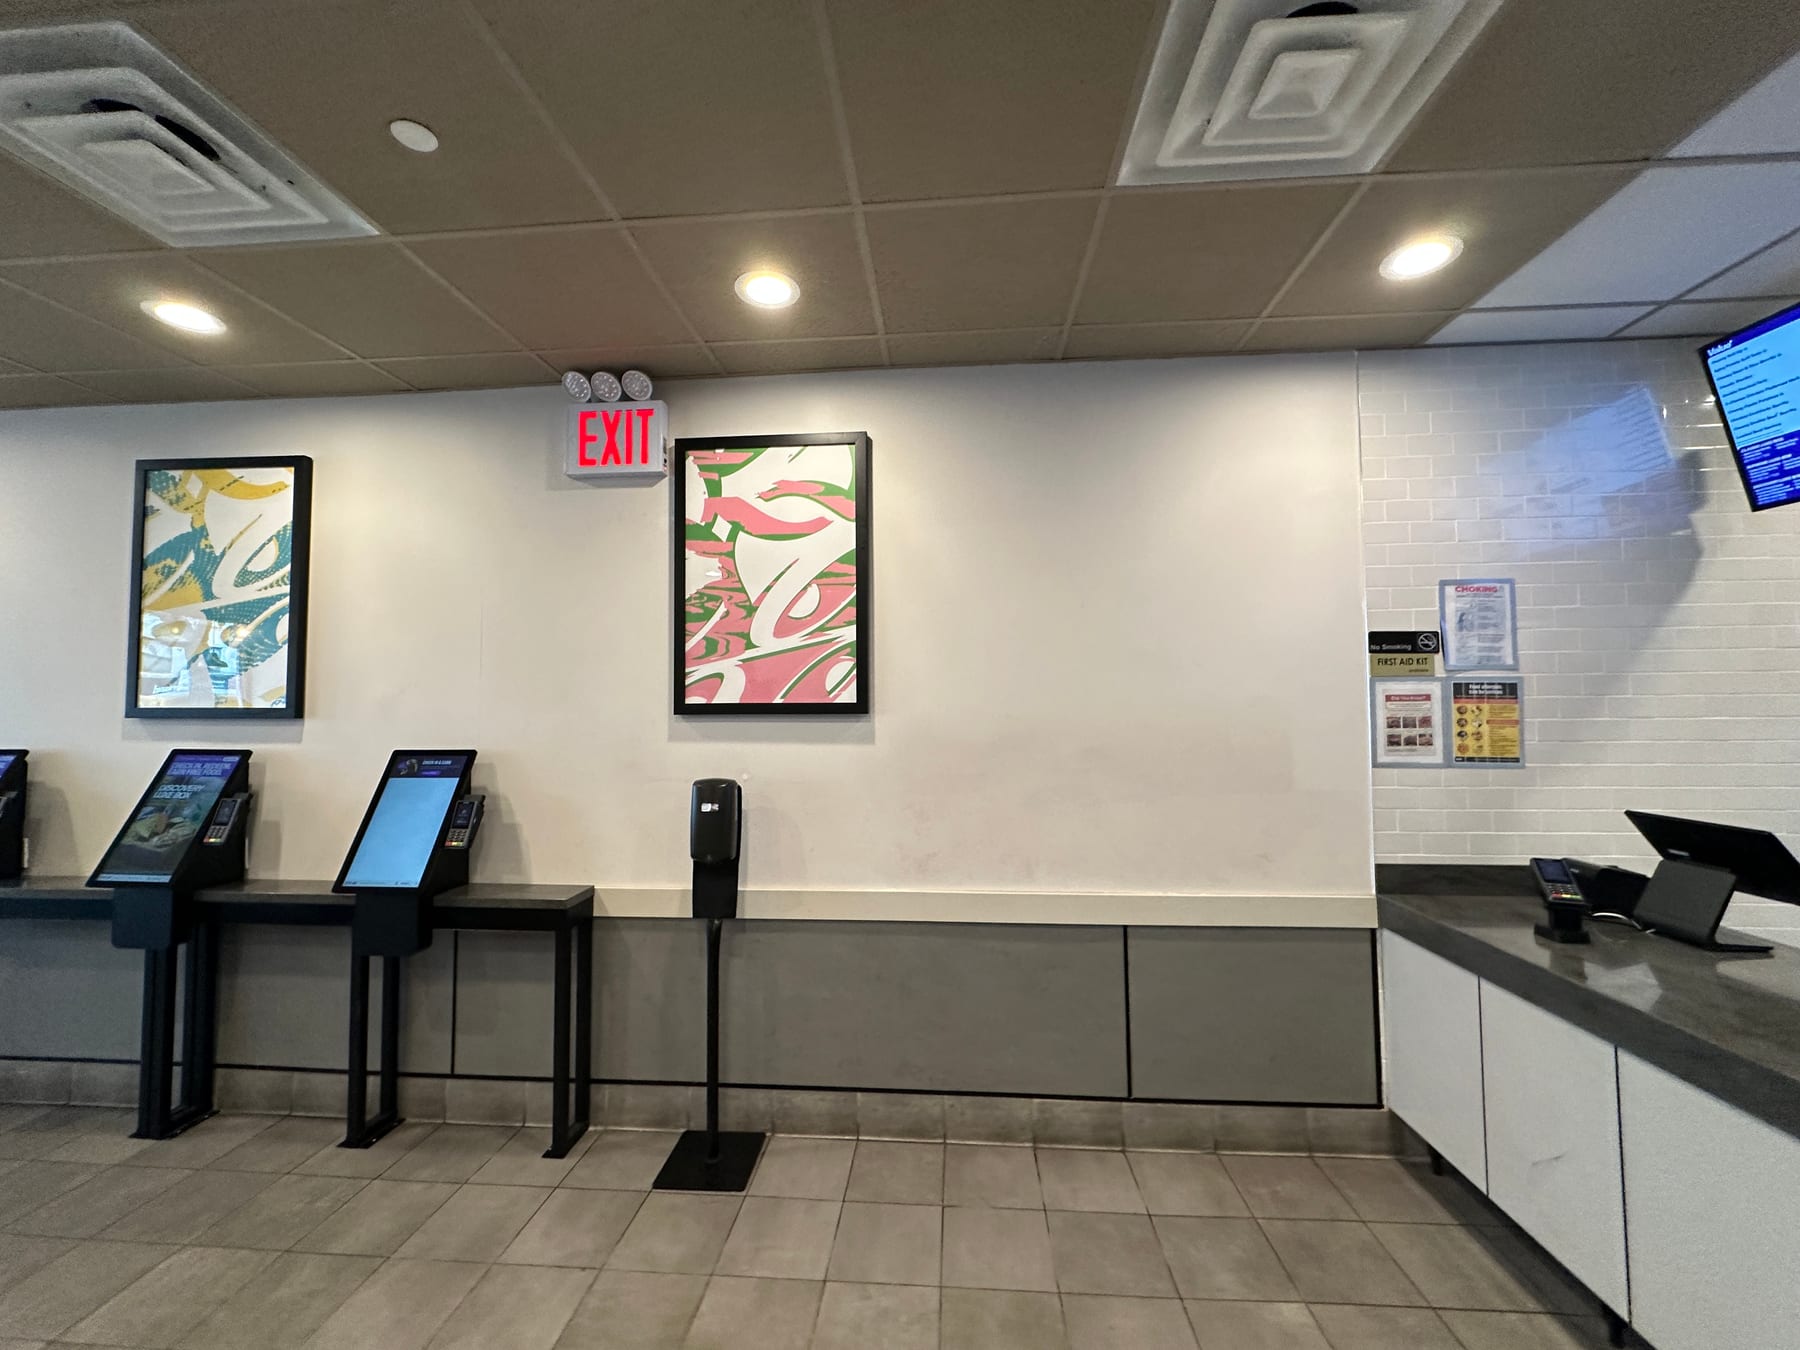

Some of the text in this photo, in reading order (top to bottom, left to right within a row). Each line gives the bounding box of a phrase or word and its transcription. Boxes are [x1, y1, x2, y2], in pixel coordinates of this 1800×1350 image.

[578, 409, 654, 466] EXIT
[1455, 585, 1498, 593] CHOKING
[1382, 643, 1412, 651] Smoking
[1377, 657, 1428, 666] FIRST AID KIT
[159, 784, 205, 792] DISCOVERY
